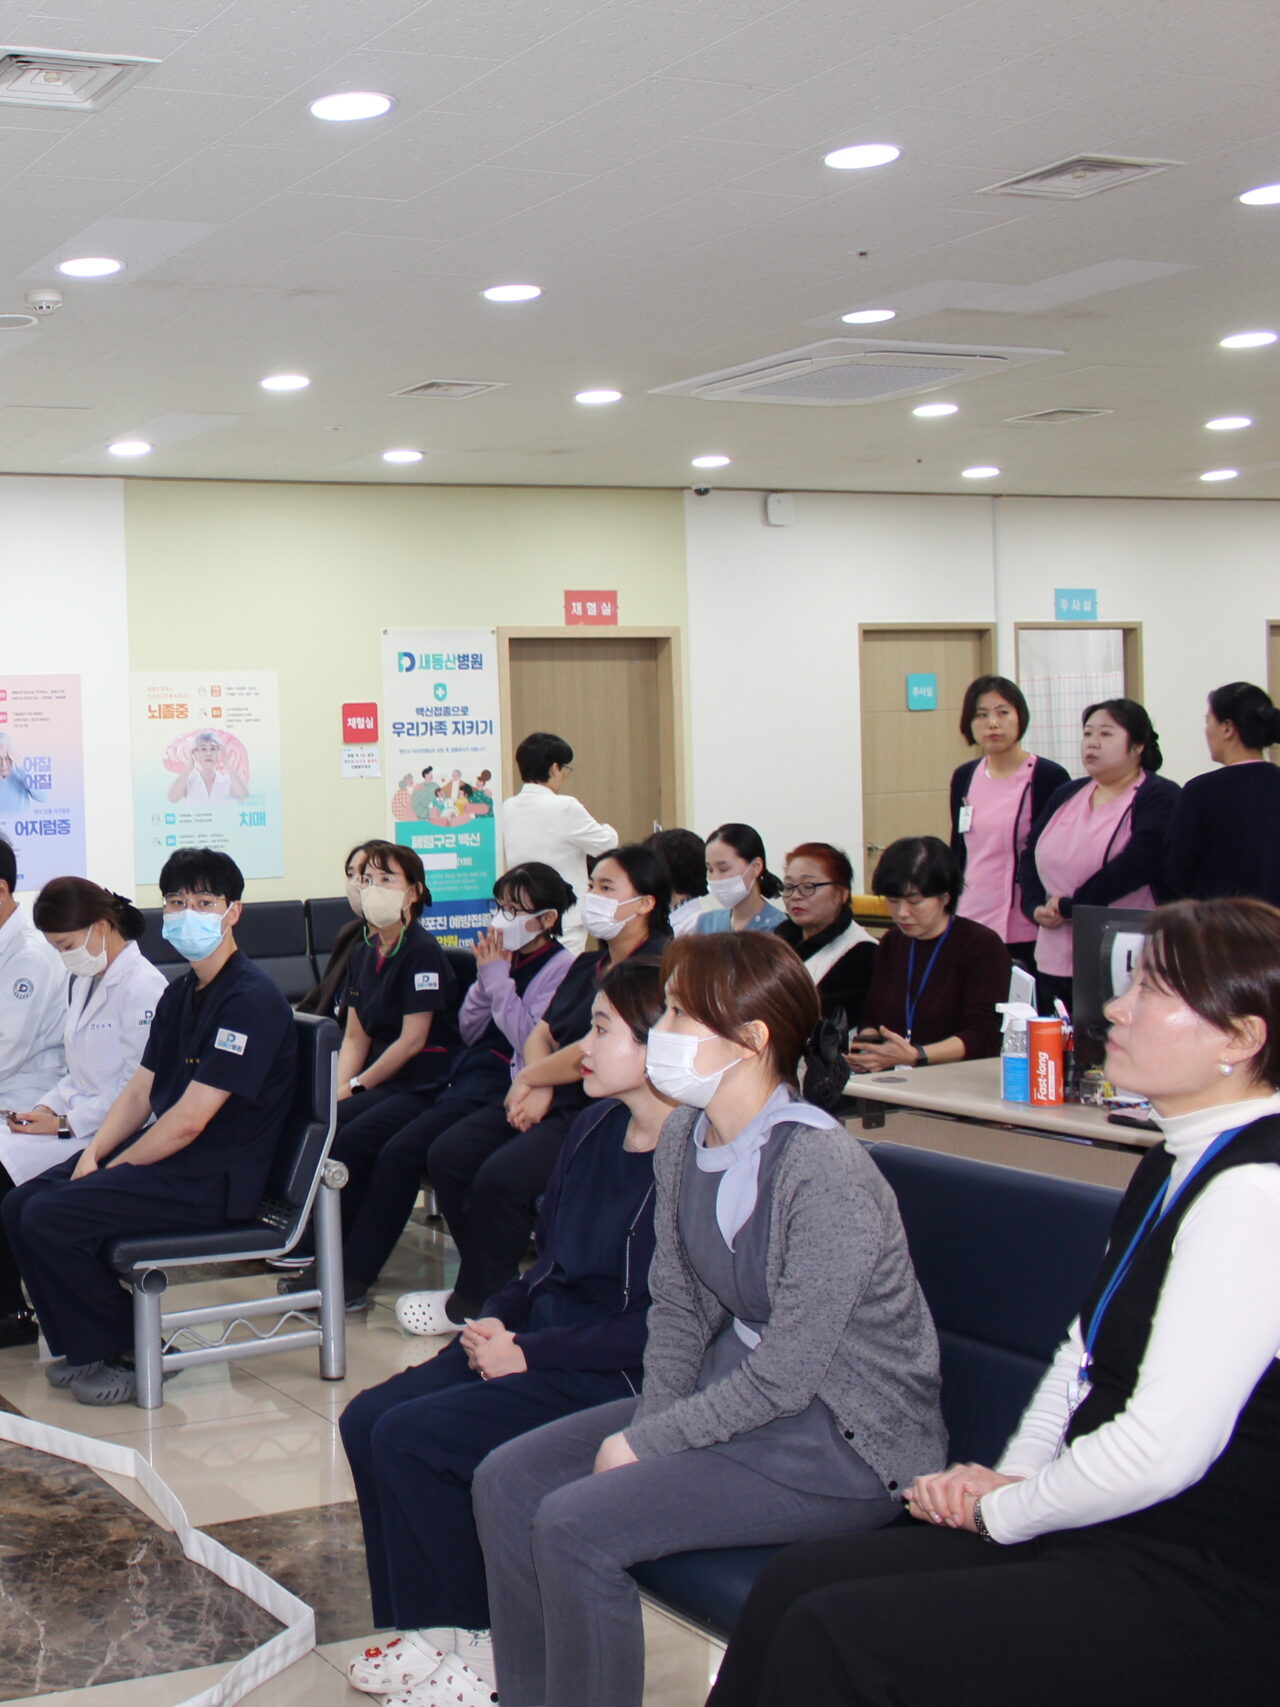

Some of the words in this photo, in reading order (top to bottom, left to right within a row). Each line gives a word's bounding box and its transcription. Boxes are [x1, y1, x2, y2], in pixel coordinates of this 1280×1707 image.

[418, 653, 484, 671] 새동산병원
[147, 703, 190, 720] 뇌졸중
[392, 721, 448, 738] 우리가족
[451, 720, 494, 736] 지키기
[14, 819, 71, 837] 어지럼증
[239, 812, 266, 827] 치매
[418, 915, 447, 931] 포진
